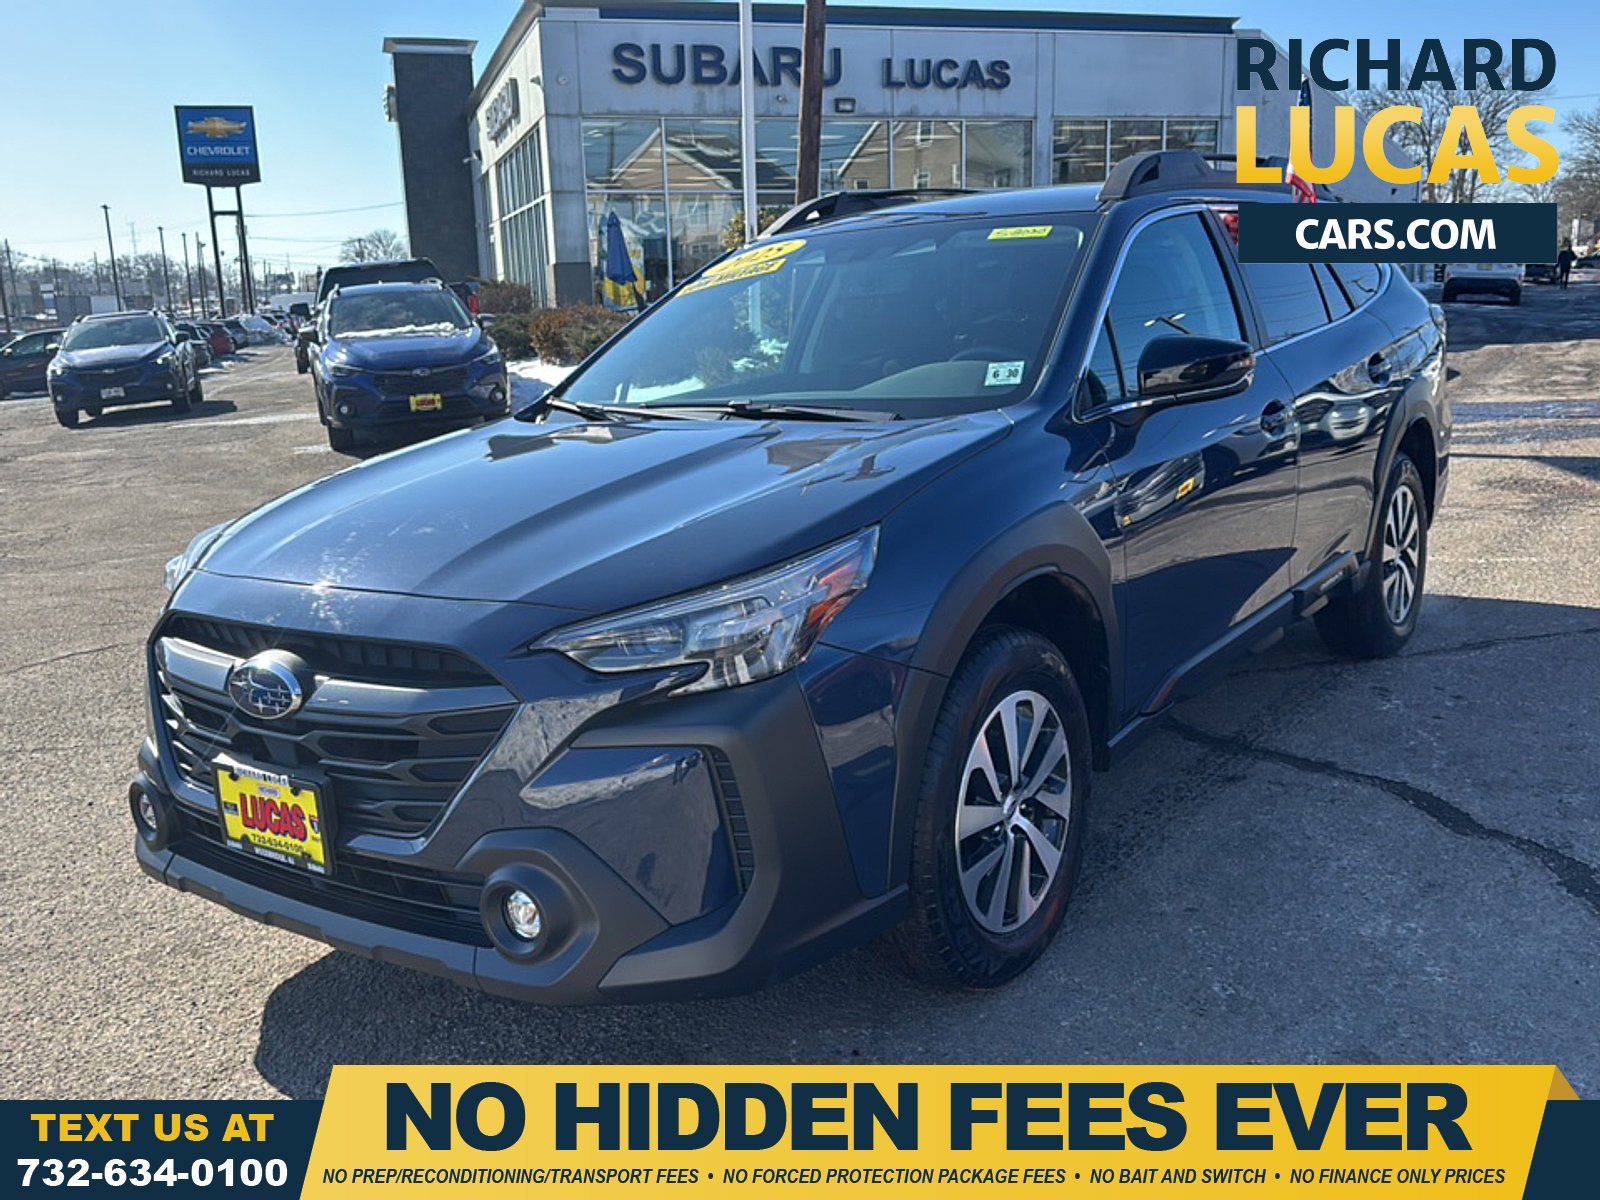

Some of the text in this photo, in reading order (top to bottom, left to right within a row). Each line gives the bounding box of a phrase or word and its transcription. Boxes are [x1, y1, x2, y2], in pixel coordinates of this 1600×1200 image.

[882, 57, 1011, 90] LUCAS
[186, 146, 250, 156] CHEVROLET
[227, 169, 250, 177] LUCAS
[239, 793, 308, 842] LUCAS
